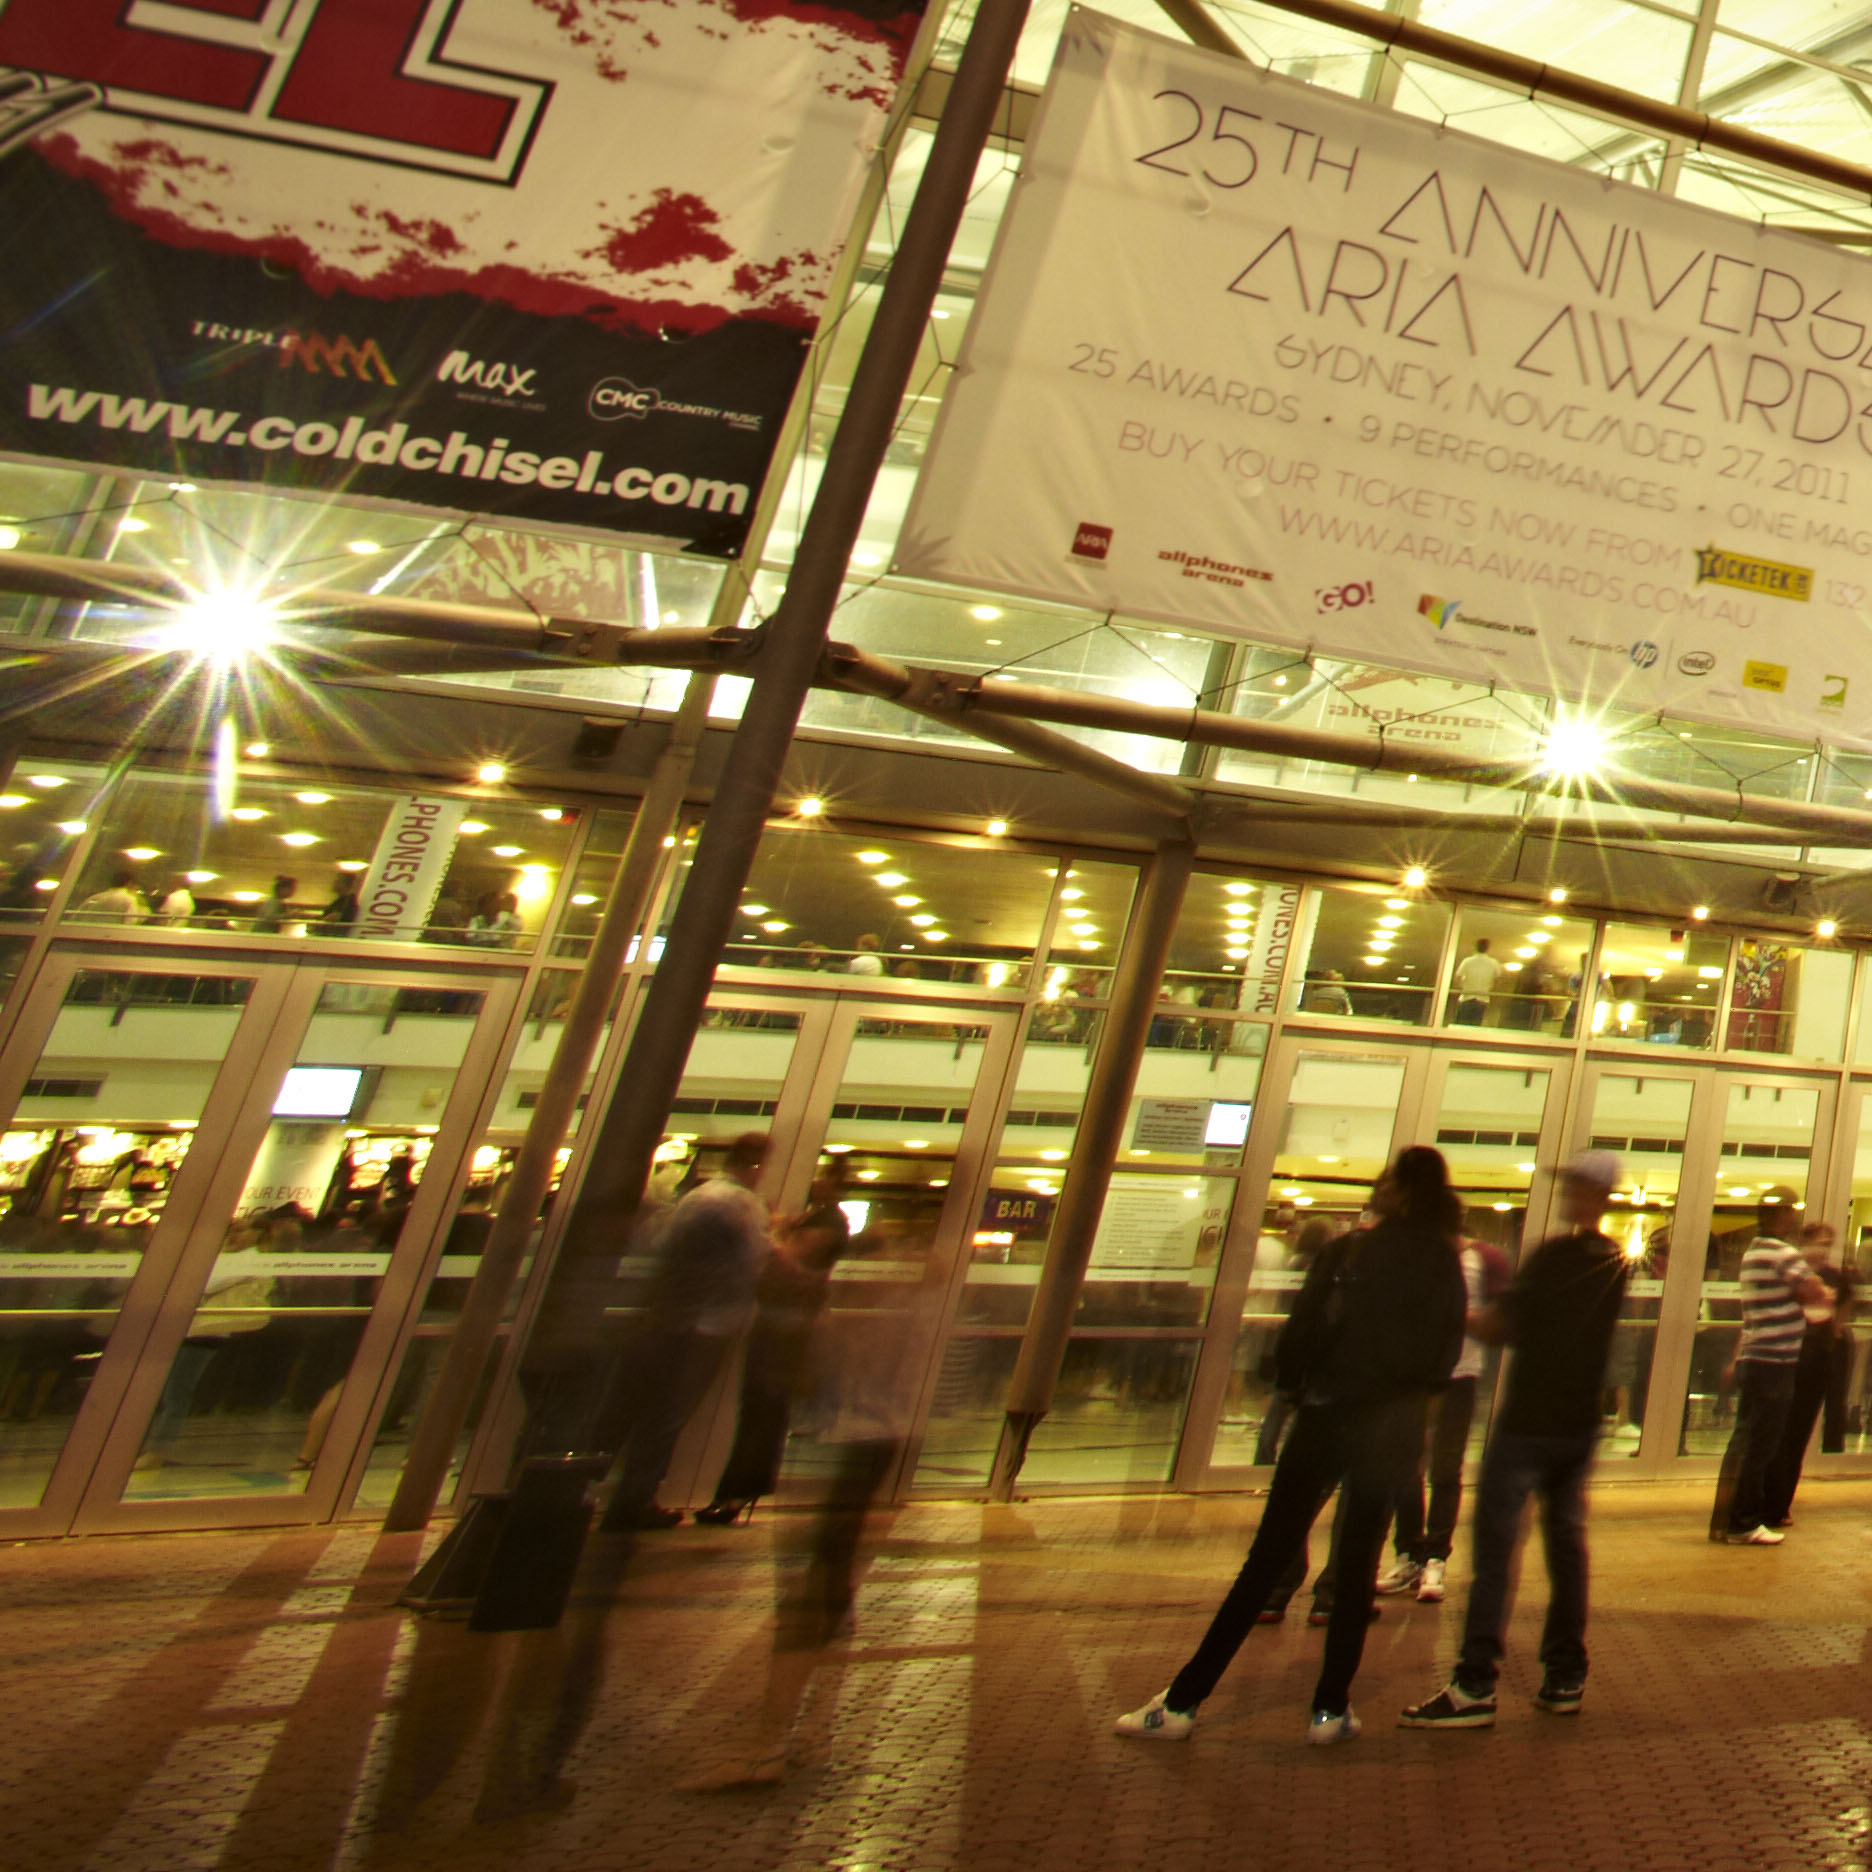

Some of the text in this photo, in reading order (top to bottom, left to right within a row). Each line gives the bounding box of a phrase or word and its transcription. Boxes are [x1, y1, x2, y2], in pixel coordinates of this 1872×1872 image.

[1133, 89, 1361, 193] 25TH
[1227, 225, 1477, 358] ARIA
[27, 382, 750, 516] www.coldchisel.com
[595, 388, 763, 426] CMC COUNTRY MUSIC
[1068, 342, 1119, 379] 25
[1126, 358, 1301, 425] AWARDS
[1358, 414, 1382, 444] 9
[1390, 421, 1679, 514] PERFORMANCES
[1726, 501, 1797, 540] ONE
[1274, 333, 1454, 413] SYDNEY,
[1718, 444, 1764, 488] 27,
[1772, 457, 1850, 505] 2011
[1118, 419, 1204, 463] BUY
[1217, 441, 1321, 493] YOUR
[1336, 469, 1478, 529] TICKETS
[1489, 506, 1579, 549] NOW
[1583, 528, 1685, 571] FROM
[1699, 548, 1791, 592] TICKETEK
[1825, 578, 1866, 611] 132
[1157, 549, 1275, 583] allphones
[1279, 504, 1758, 630] WWW.ARIAAWARDS.COM.AU
[1181, 567, 1245, 588] arena
[1634, 641, 1656, 669] hp
[1328, 703, 1505, 730] allphones
[995, 1200, 1038, 1219] BAR
